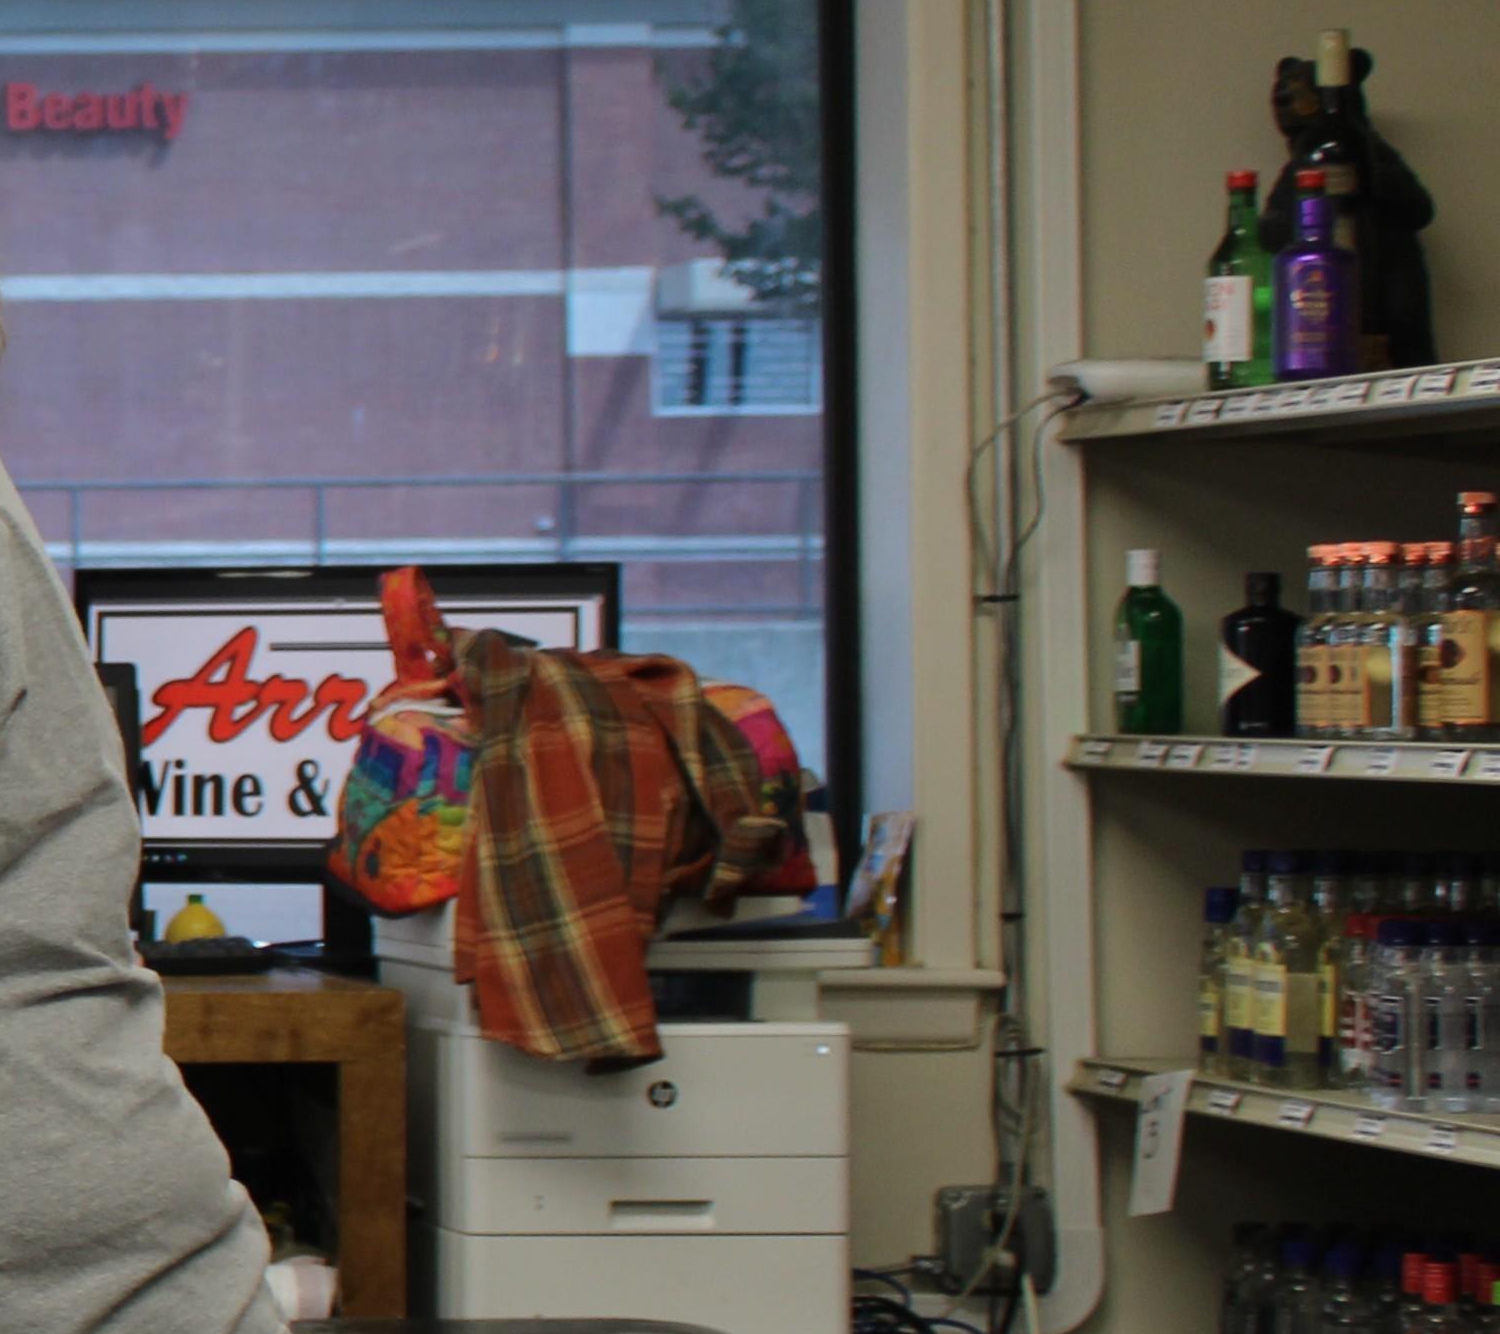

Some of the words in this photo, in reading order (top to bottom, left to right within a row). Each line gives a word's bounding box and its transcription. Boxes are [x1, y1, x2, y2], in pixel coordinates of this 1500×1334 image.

[7, 83, 187, 140] Beauty
[142, 626, 380, 744] Arr
[288, 759, 331, 820] &
